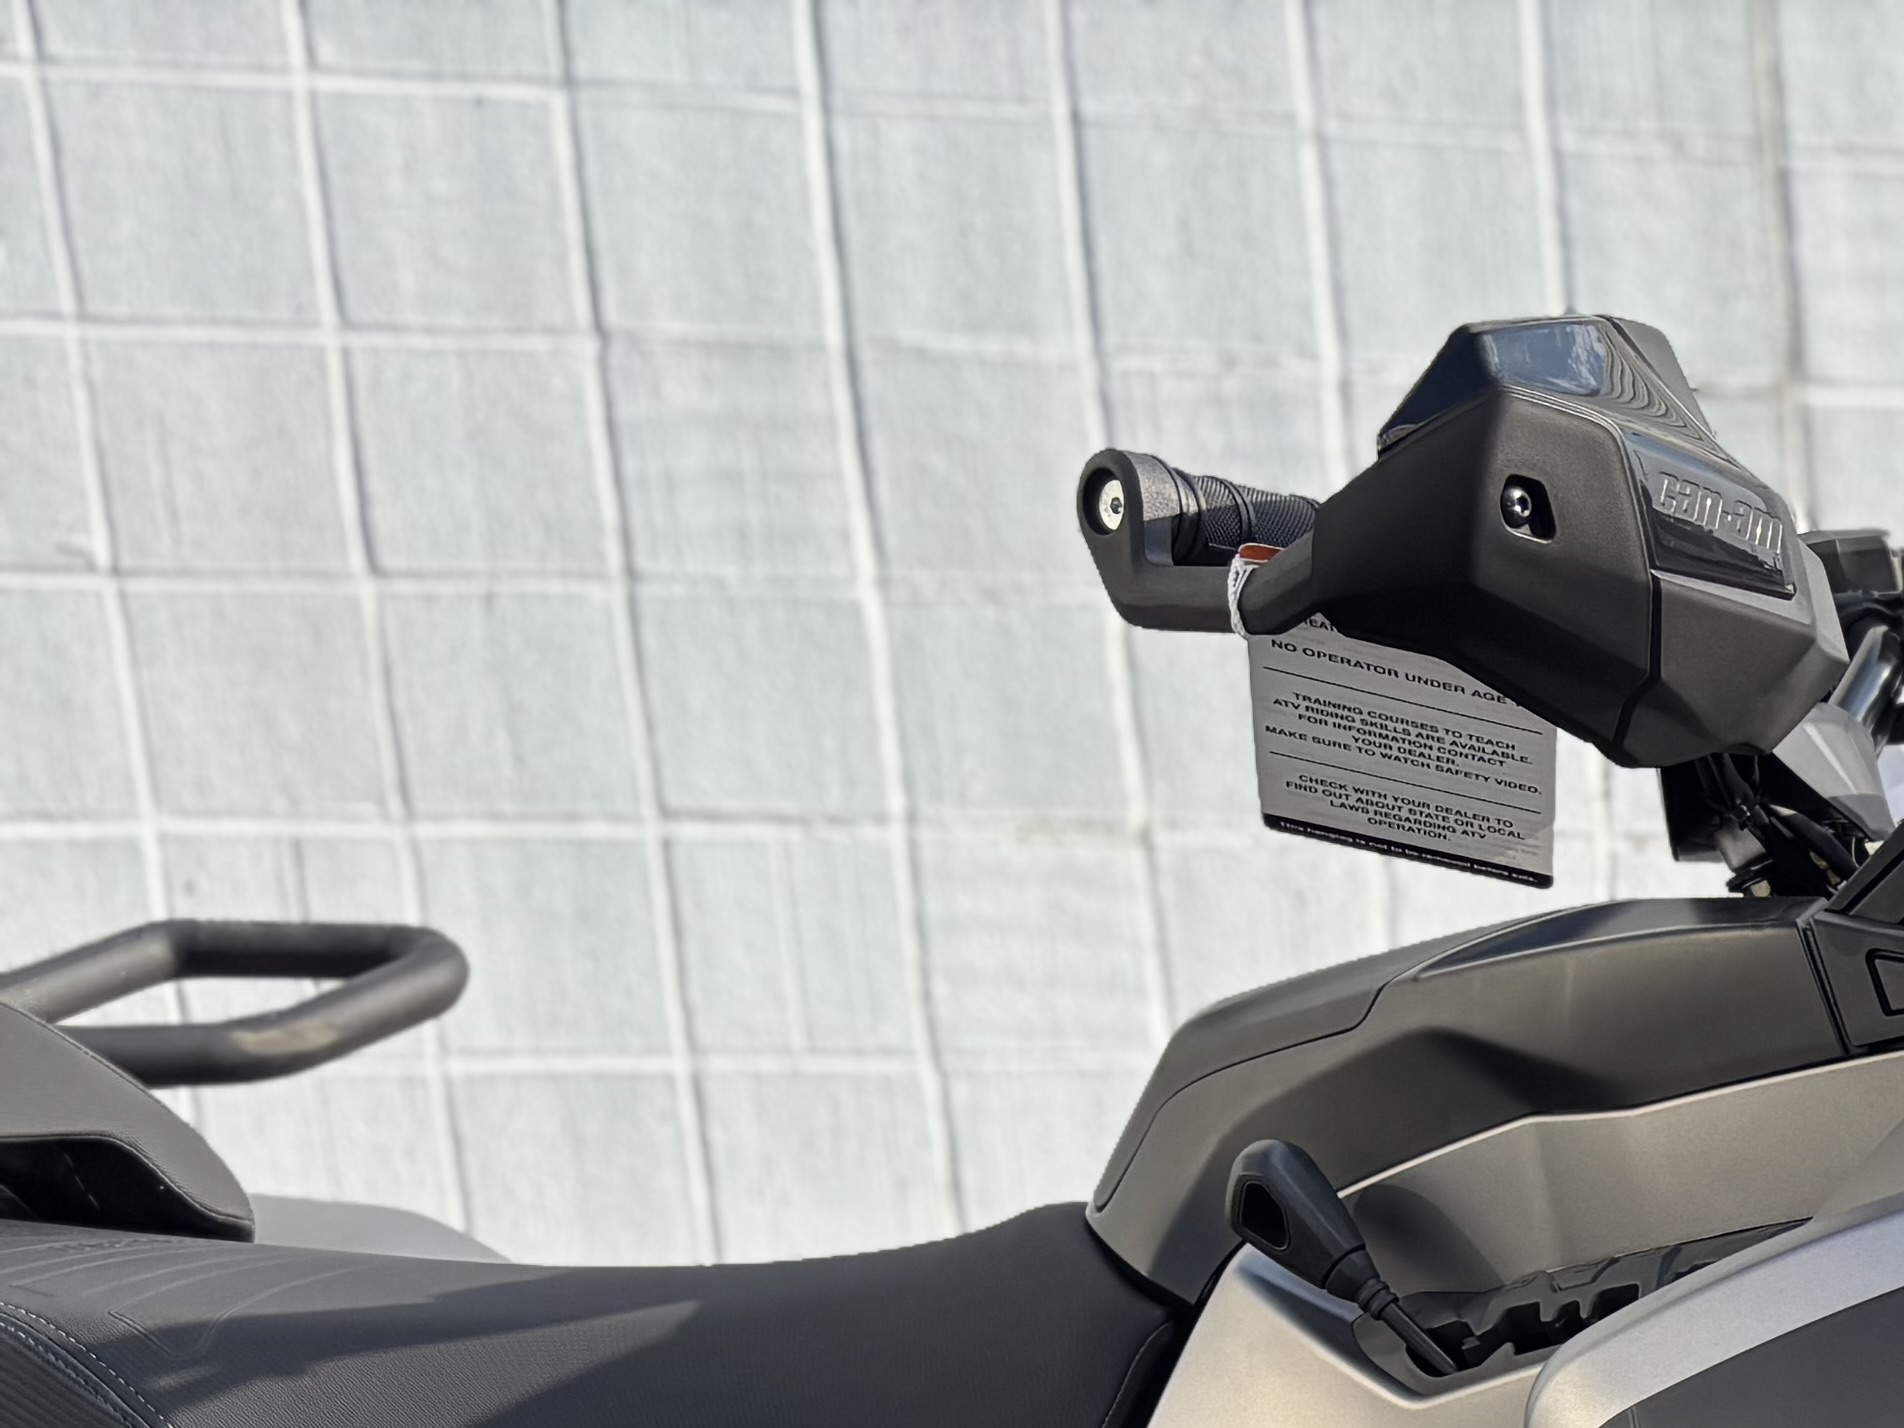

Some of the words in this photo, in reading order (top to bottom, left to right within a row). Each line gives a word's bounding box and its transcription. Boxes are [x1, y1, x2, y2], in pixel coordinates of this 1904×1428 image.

[1271, 639, 1298, 653] NO
[1302, 647, 1399, 678] OPERATOR
[1404, 672, 1466, 695] UNDER
[1470, 689, 1508, 705] AGE
[1272, 698, 1300, 710] ATV
[1305, 705, 1356, 723] RIDING
[1360, 718, 1412, 737] SKILLS
[1415, 732, 1446, 745] ARE
[1449, 740, 1533, 765] AVAILABLE.
[1292, 692, 1364, 716] TRAINING
[1367, 710, 1439, 733] COURSES
[1443, 727, 1463, 739] TO
[1466, 733, 1516, 751] TEACH
[1298, 713, 1328, 726] FOR
[1332, 721, 1433, 751] INFORMATION
[1437, 746, 1507, 767] CONTACT
[1265, 725, 1307, 741] MAKE
[1312, 736, 1352, 752] SURE
[1356, 746, 1376, 757] TO
[1380, 749, 1431, 770] WATCH
[1435, 764, 1491, 783] SAFETY
[1494, 777, 1542, 795] VIDEO.
[1351, 735, 1393, 751] YOUR
[1397, 745, 1460, 767] DEALER.
[1286, 780, 1318, 794] FIND
[1321, 789, 1352, 801] OUT
[1355, 797, 1405, 813] ABOUT
[1408, 807, 1451, 824] STATE
[1454, 818, 1476, 829] OR
[1478, 823, 1526, 841] LOCAL
[1299, 774, 1348, 792] CHECK
[1352, 786, 1387, 801] WITH
[1391, 794, 1431, 811] YOUR
[1435, 805, 1491, 823] DEALER
[1494, 817, 1514, 829] TO
[1330, 800, 1370, 815] LAWS
[1373, 808, 1457, 834] REGARDING
[1460, 829, 1487, 840] ATV
[1367, 817, 1452, 842] OPERATION.
